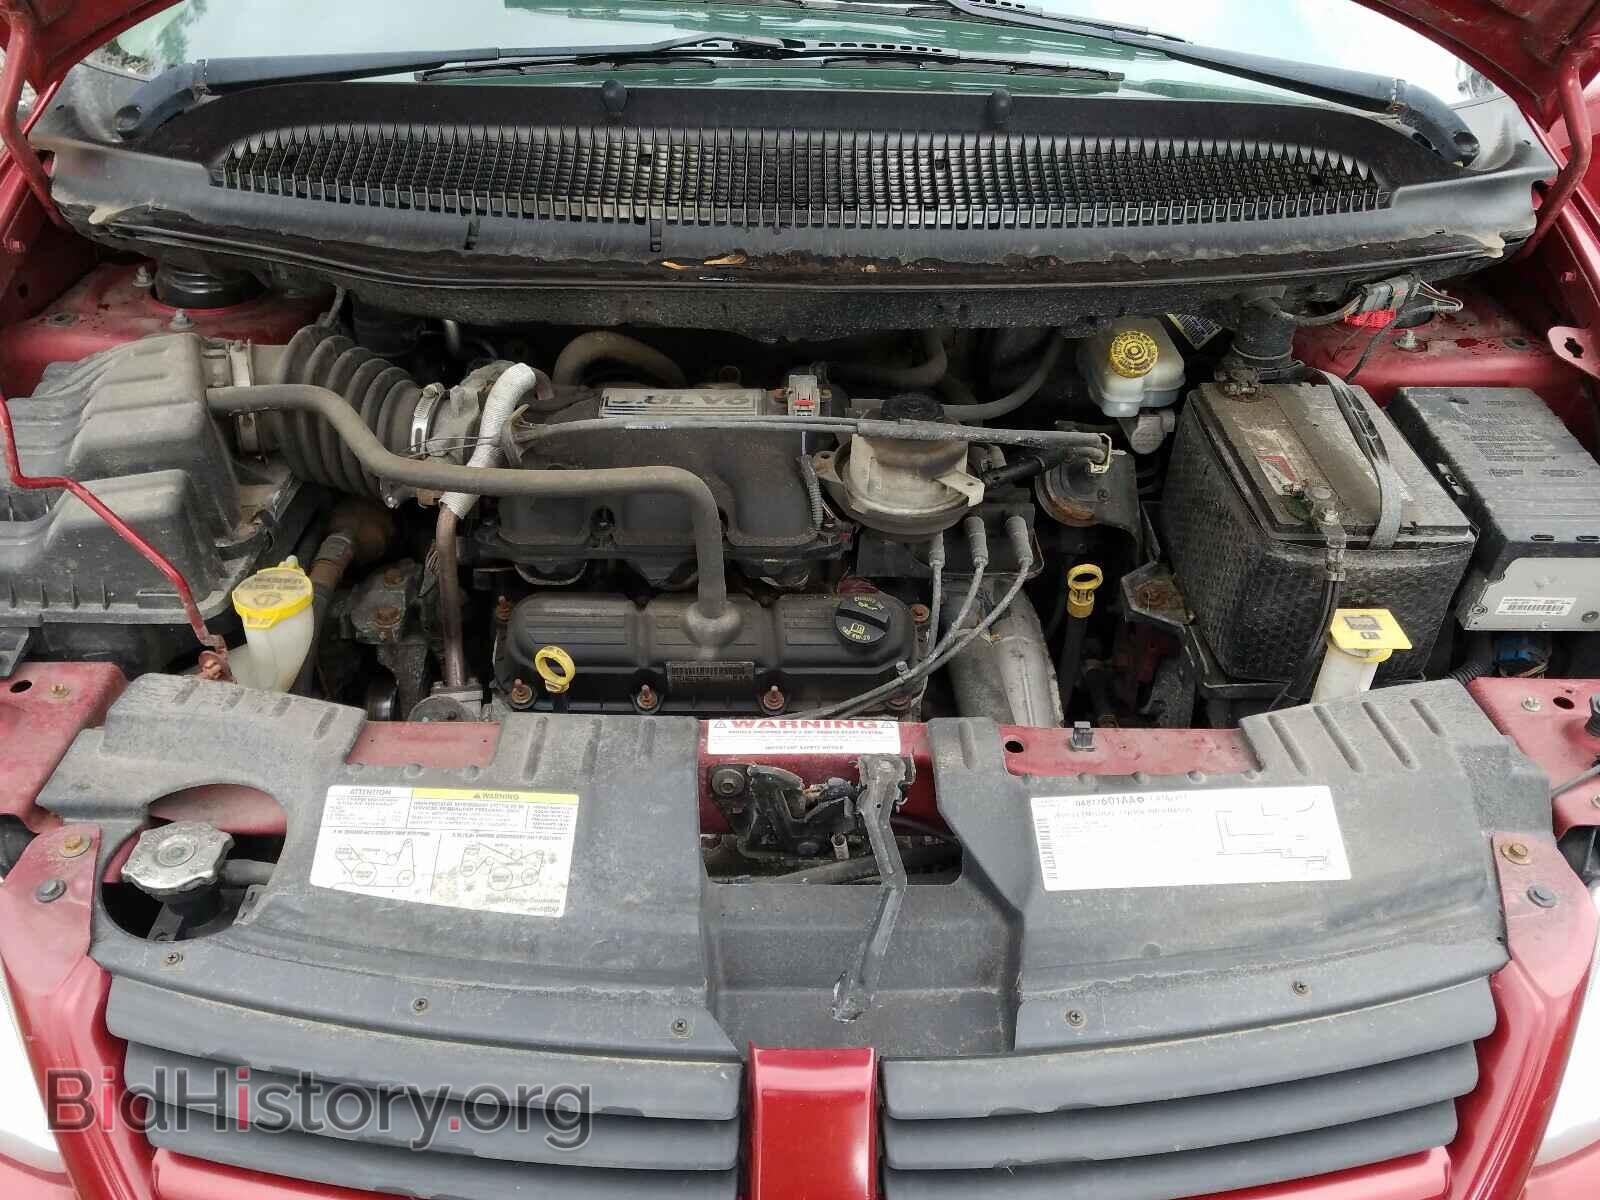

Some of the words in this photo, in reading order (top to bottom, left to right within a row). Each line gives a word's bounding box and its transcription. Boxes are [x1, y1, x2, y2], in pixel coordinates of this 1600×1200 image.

[731, 720, 878, 729] WARNING
[350, 788, 392, 796] ATTENTION
[482, 793, 519, 801] WARNING
